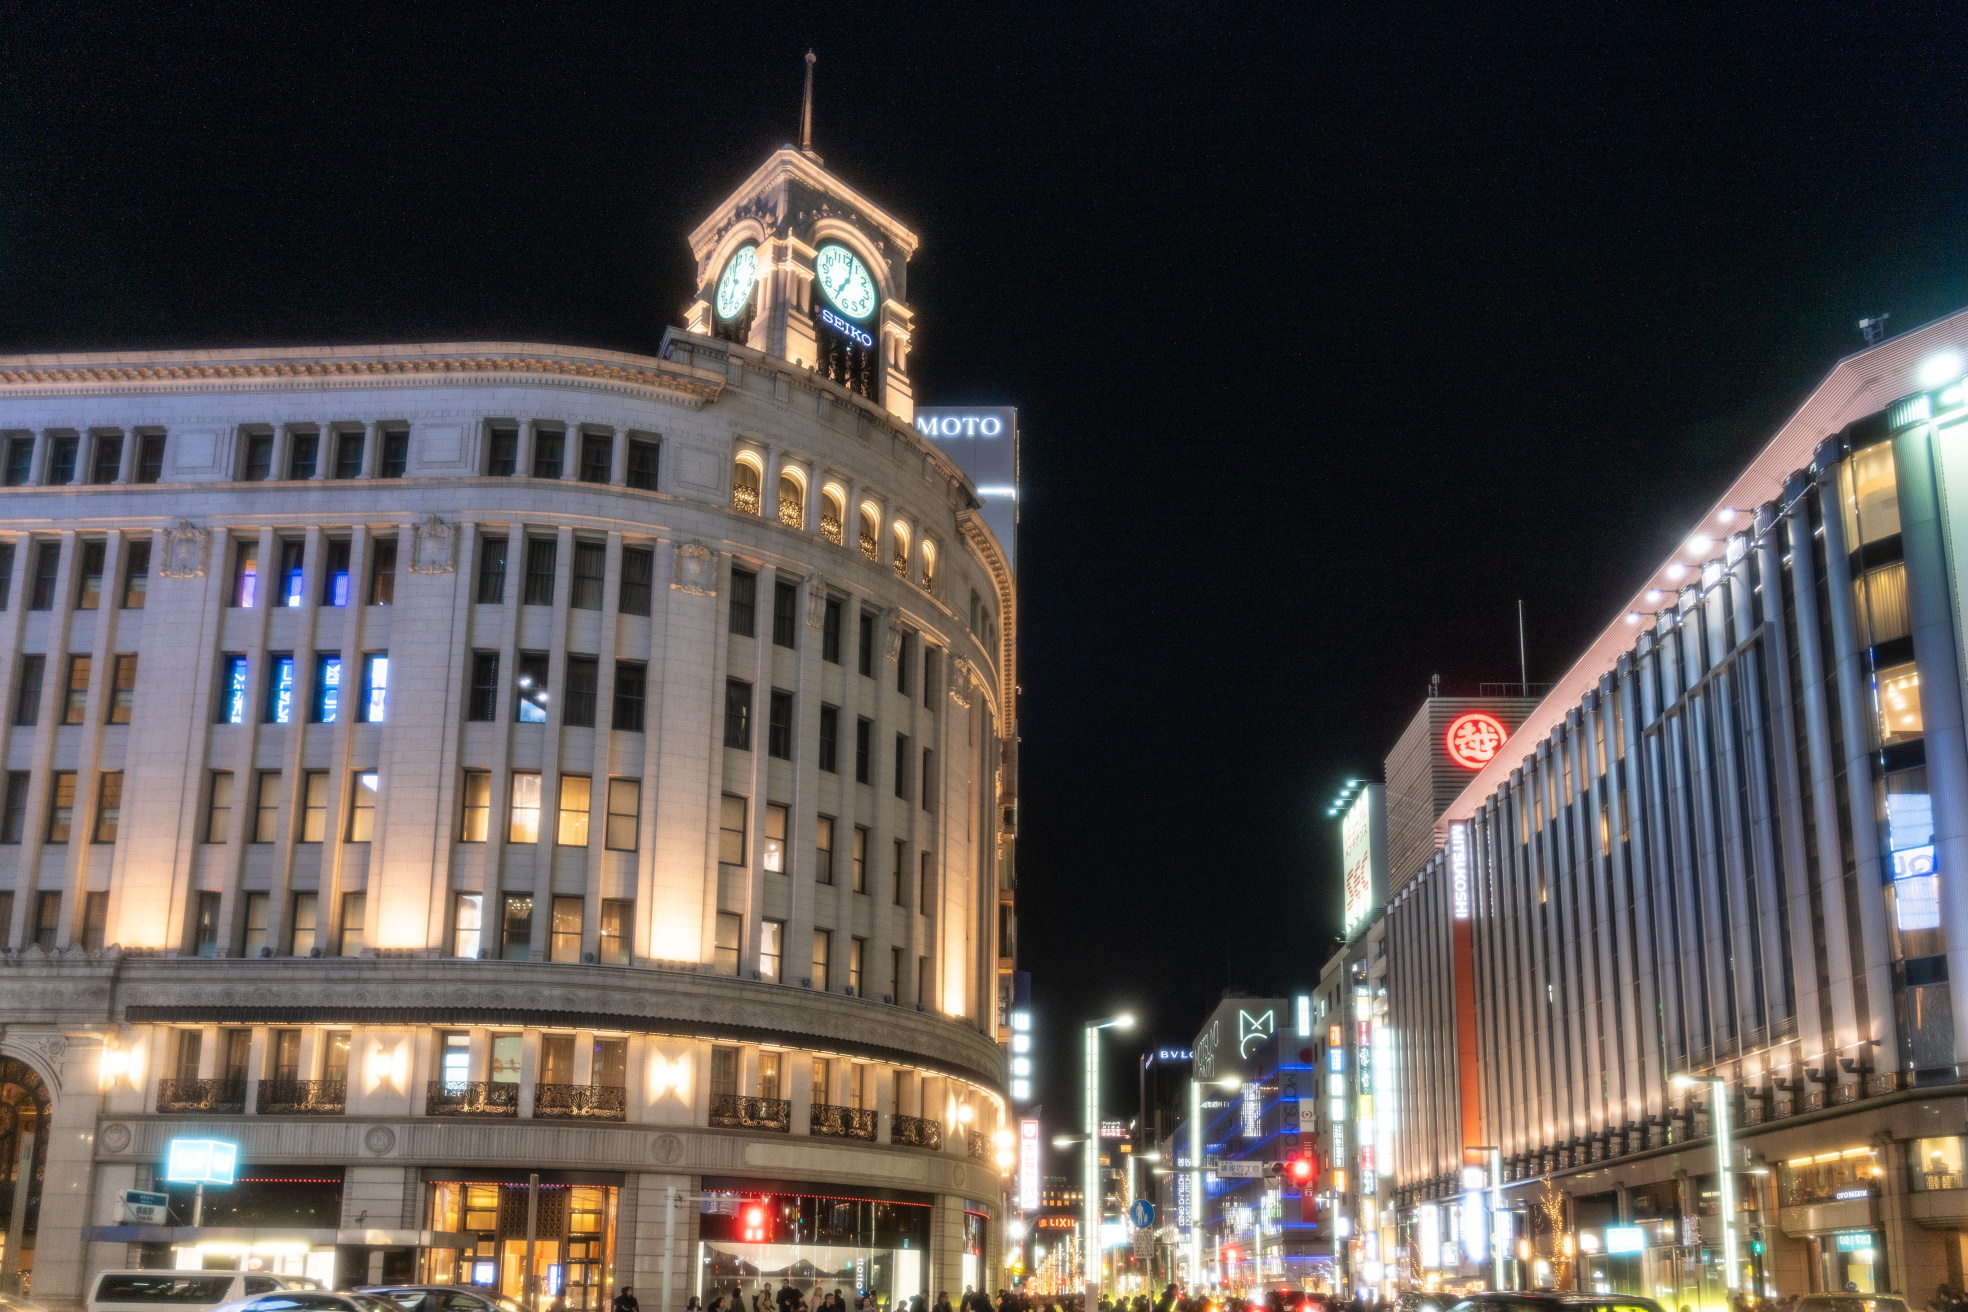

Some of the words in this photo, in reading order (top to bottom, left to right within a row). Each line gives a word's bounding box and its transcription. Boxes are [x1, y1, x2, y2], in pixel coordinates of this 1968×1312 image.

[825, 254, 834, 267] 10
[834, 251, 841, 264] 11
[822, 263, 830, 274] 9
[825, 276, 832, 288] 8
[860, 276, 867, 289] 2
[862, 289, 870, 301] 3
[841, 298, 849, 309] 6
[858, 298, 867, 310] 4
[822, 309, 872, 347] SEIKO
[917, 417, 1000, 435] MOTO
[1454, 720, 1500, 761] 越
[1452, 825, 1468, 918] MITSUKOSHI
[1221, 1165, 1260, 1173] 銀座四丁目
[1049, 1218, 1077, 1228] LIXIL
